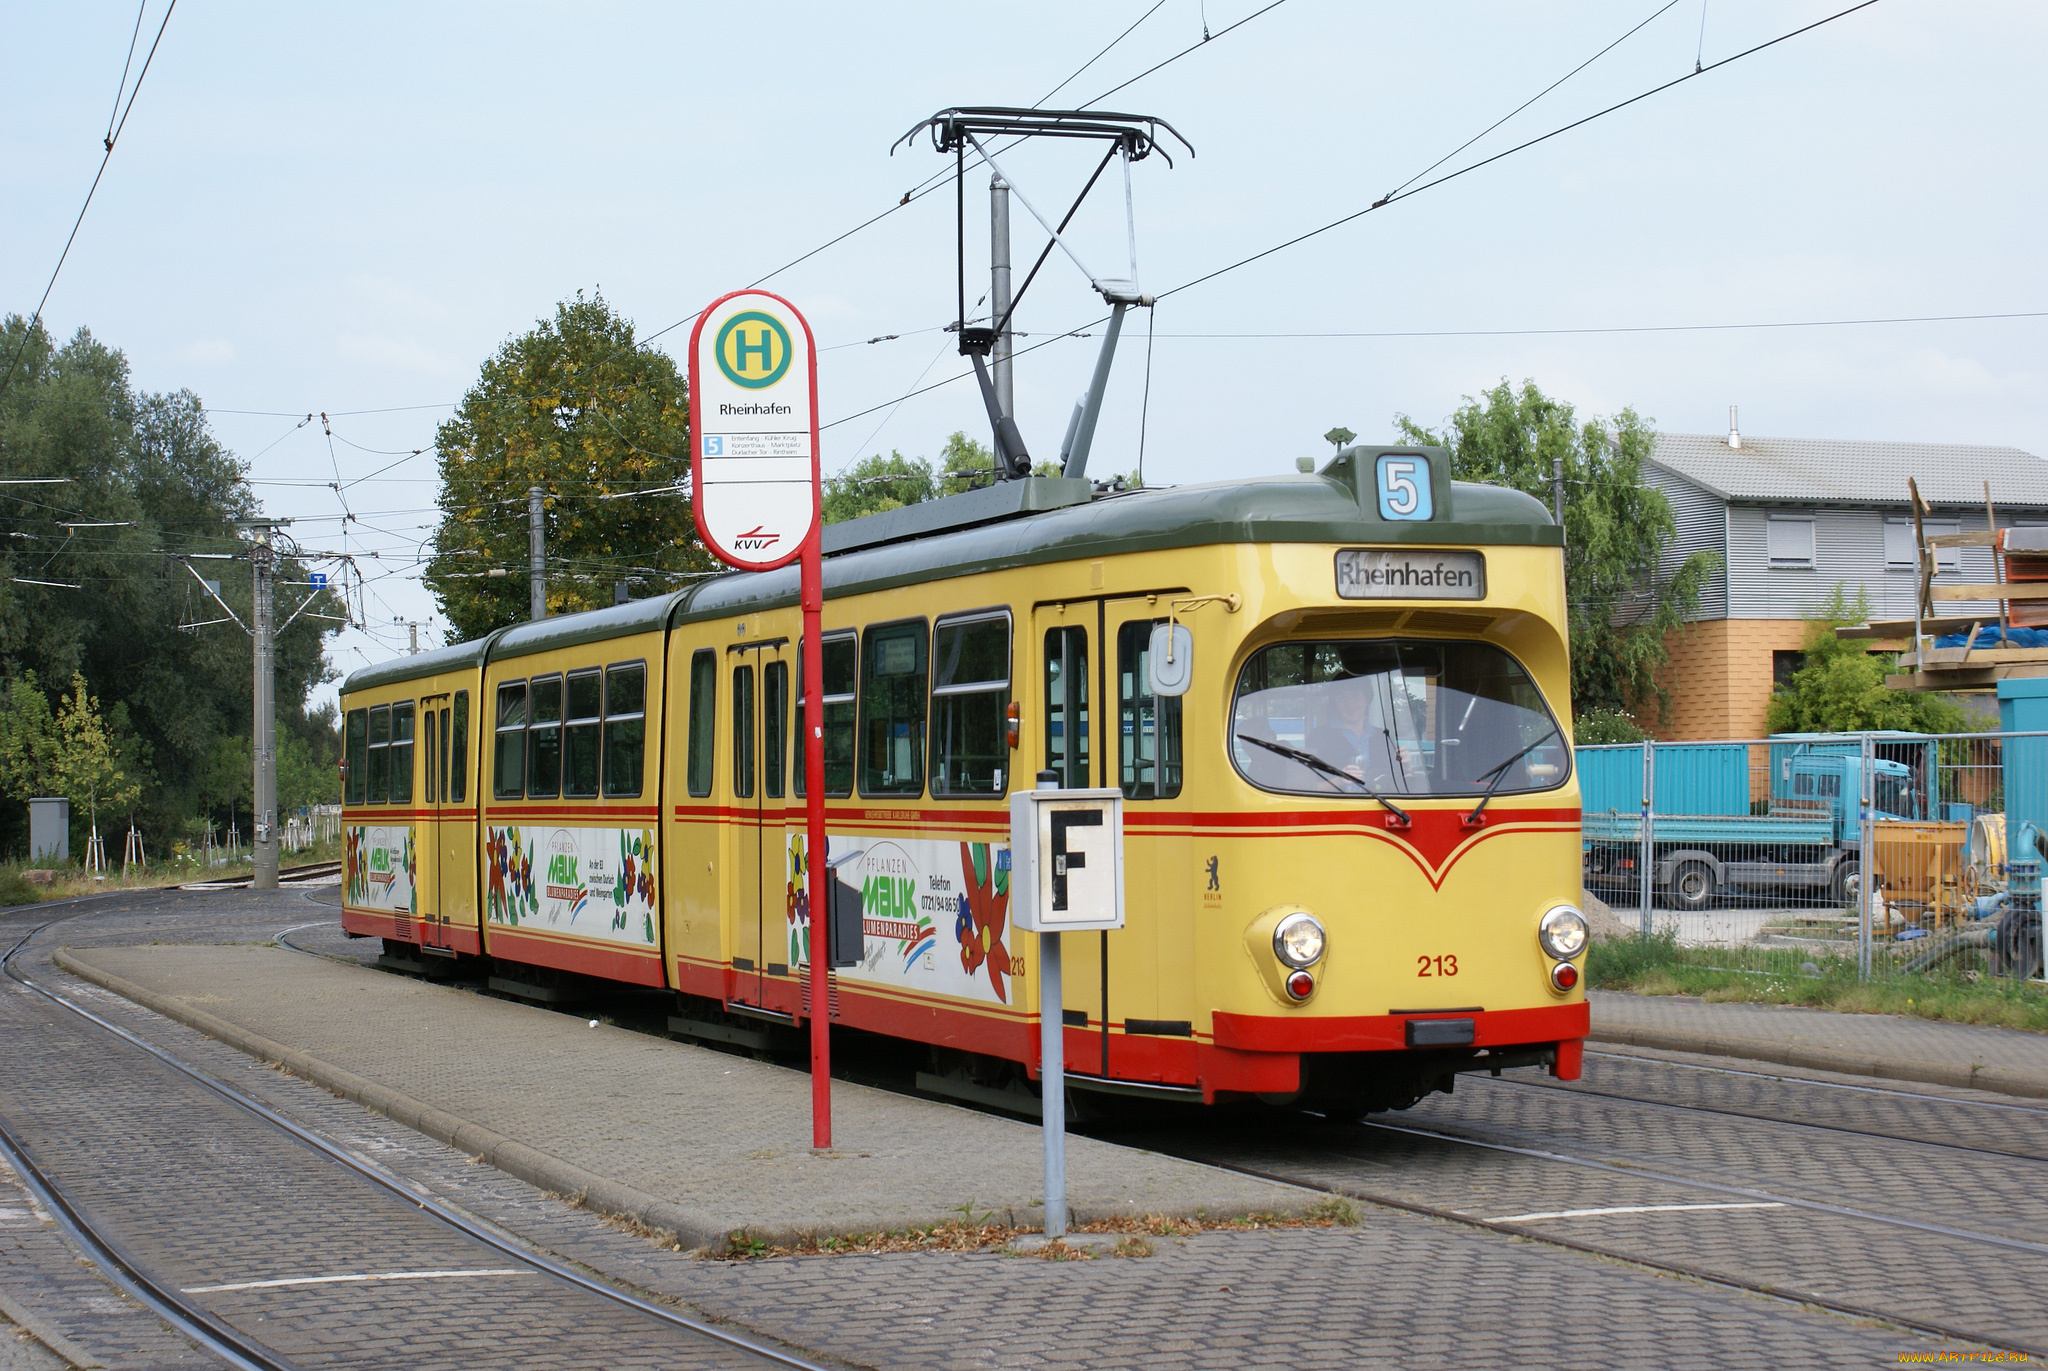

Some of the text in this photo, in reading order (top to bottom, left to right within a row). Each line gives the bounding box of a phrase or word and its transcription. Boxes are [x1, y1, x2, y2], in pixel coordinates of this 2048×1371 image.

[736, 330, 772, 371] H
[720, 402, 791, 415] Rheinhafen
[708, 438, 719, 454] 5
[1385, 461, 1419, 515] 5
[734, 539, 763, 550] KVV
[1338, 562, 1473, 588] Rheinhafen
[552, 841, 574, 853] PFLANZEN
[867, 857, 907, 874] PFLANZEN
[1050, 809, 1104, 911] F
[929, 875, 951, 892] Telefon
[863, 920, 918, 939] LUMENPARADIES
[1011, 955, 1026, 977] 213
[1417, 954, 1459, 977] 213
